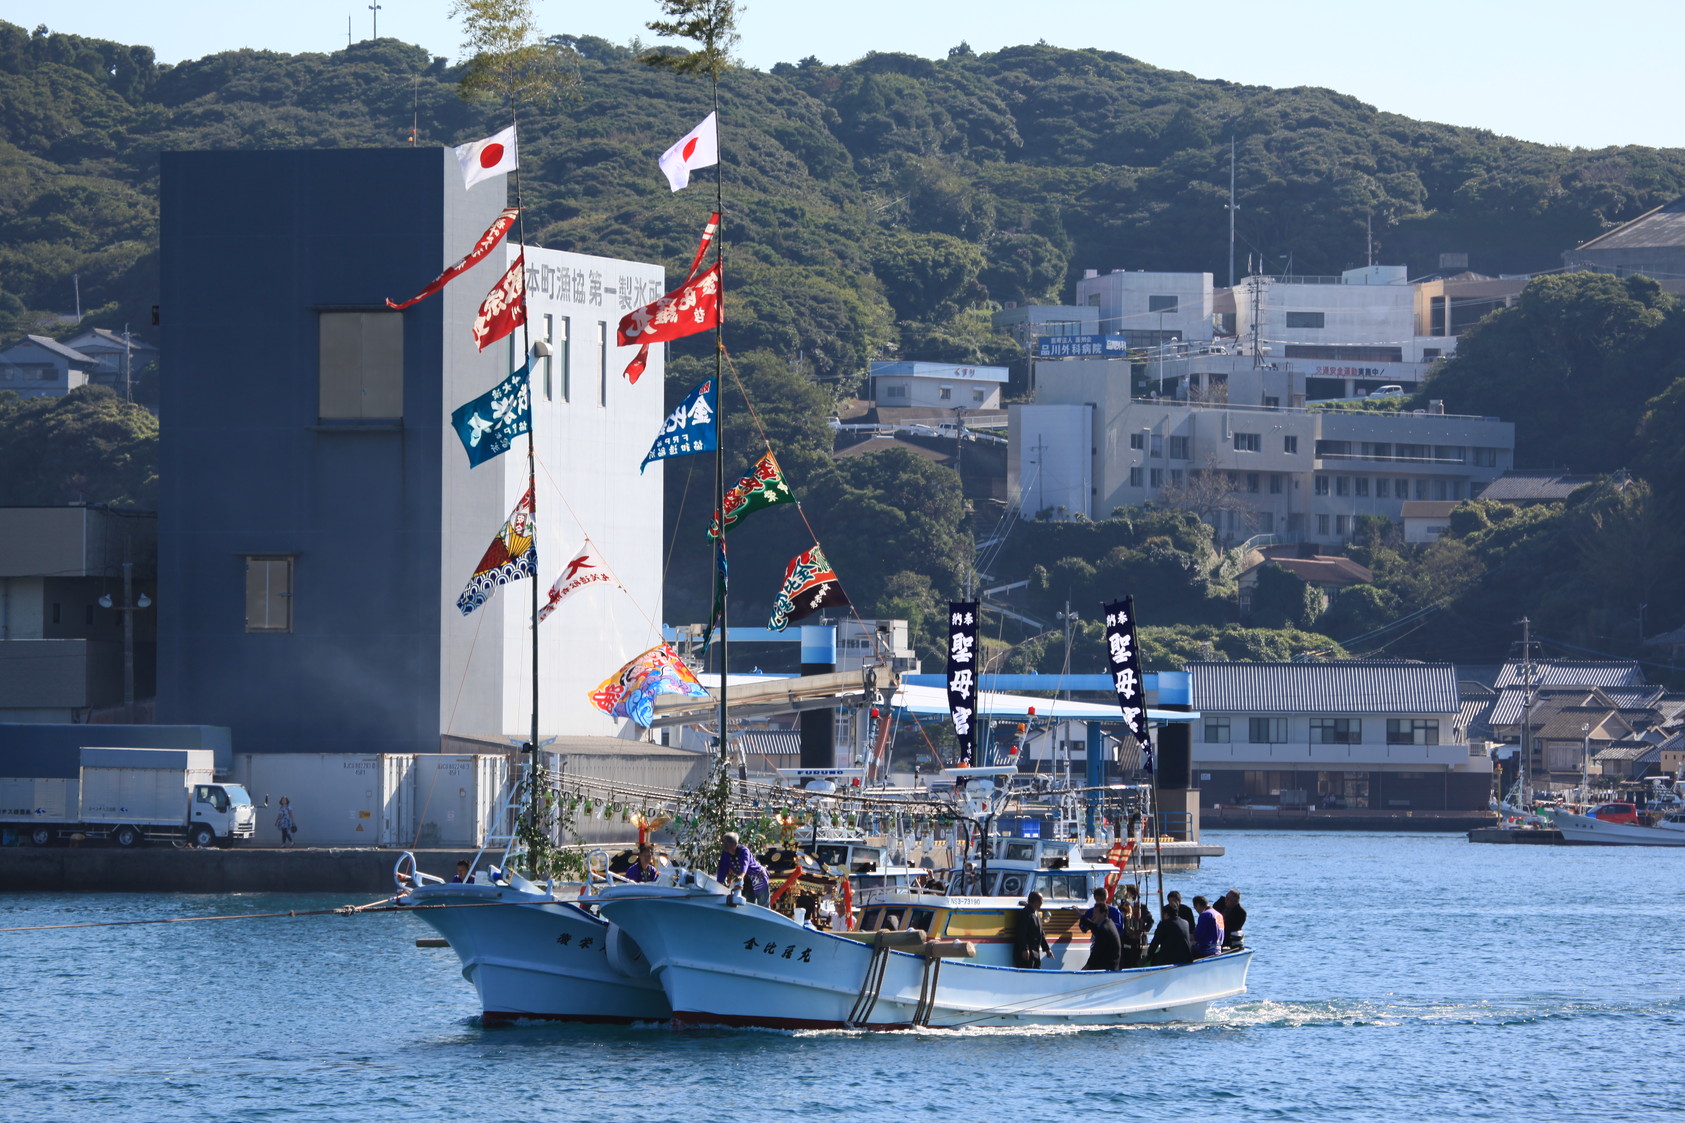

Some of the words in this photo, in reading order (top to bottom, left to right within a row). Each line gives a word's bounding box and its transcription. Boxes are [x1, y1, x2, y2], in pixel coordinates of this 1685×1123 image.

[511, 259, 662, 310] 本町漁協第一製氷所
[1041, 343, 1102, 356] 品川外科病院
[955, 368, 976, 378] くすり
[950, 632, 974, 735] 聖母宮
